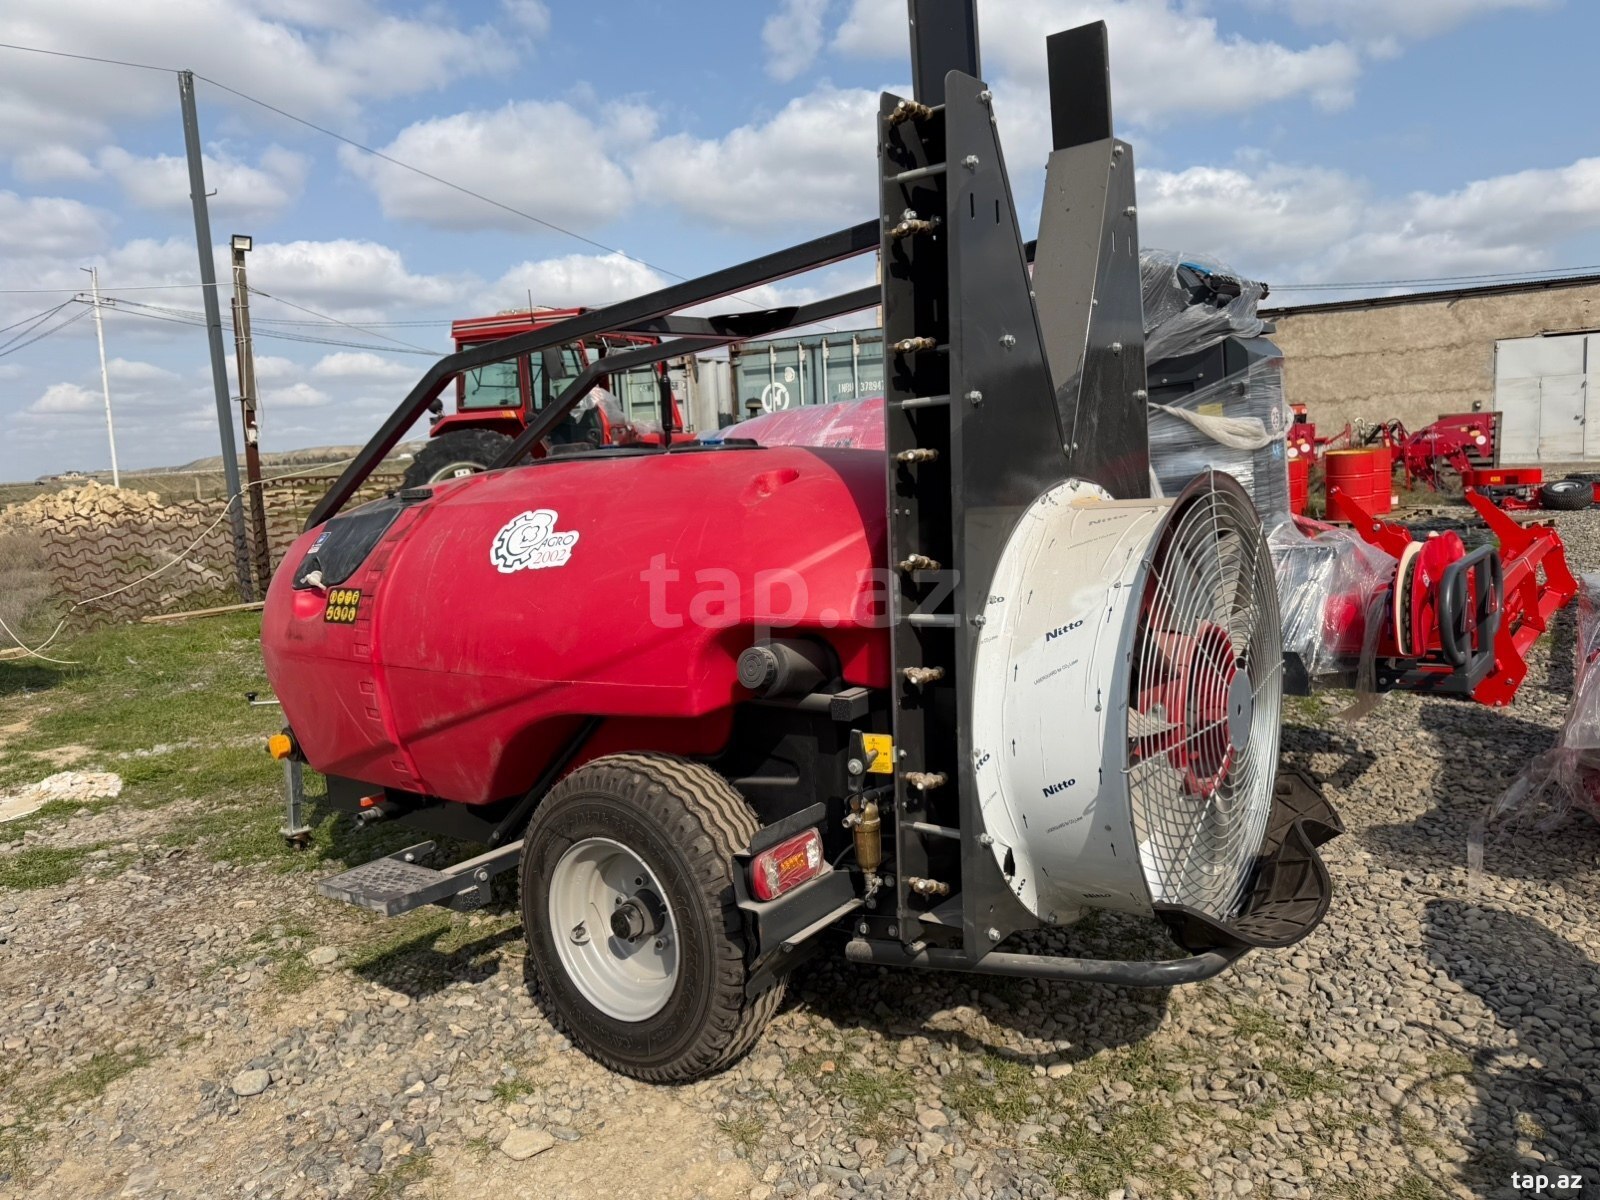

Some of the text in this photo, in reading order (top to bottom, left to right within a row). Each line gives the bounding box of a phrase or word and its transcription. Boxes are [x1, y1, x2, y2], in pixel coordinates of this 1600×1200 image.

[541, 535, 575, 547] AGRO
[533, 549, 566, 564] 2002
[1045, 619, 1084, 642] Nitto
[1042, 777, 1076, 798] Nitto
